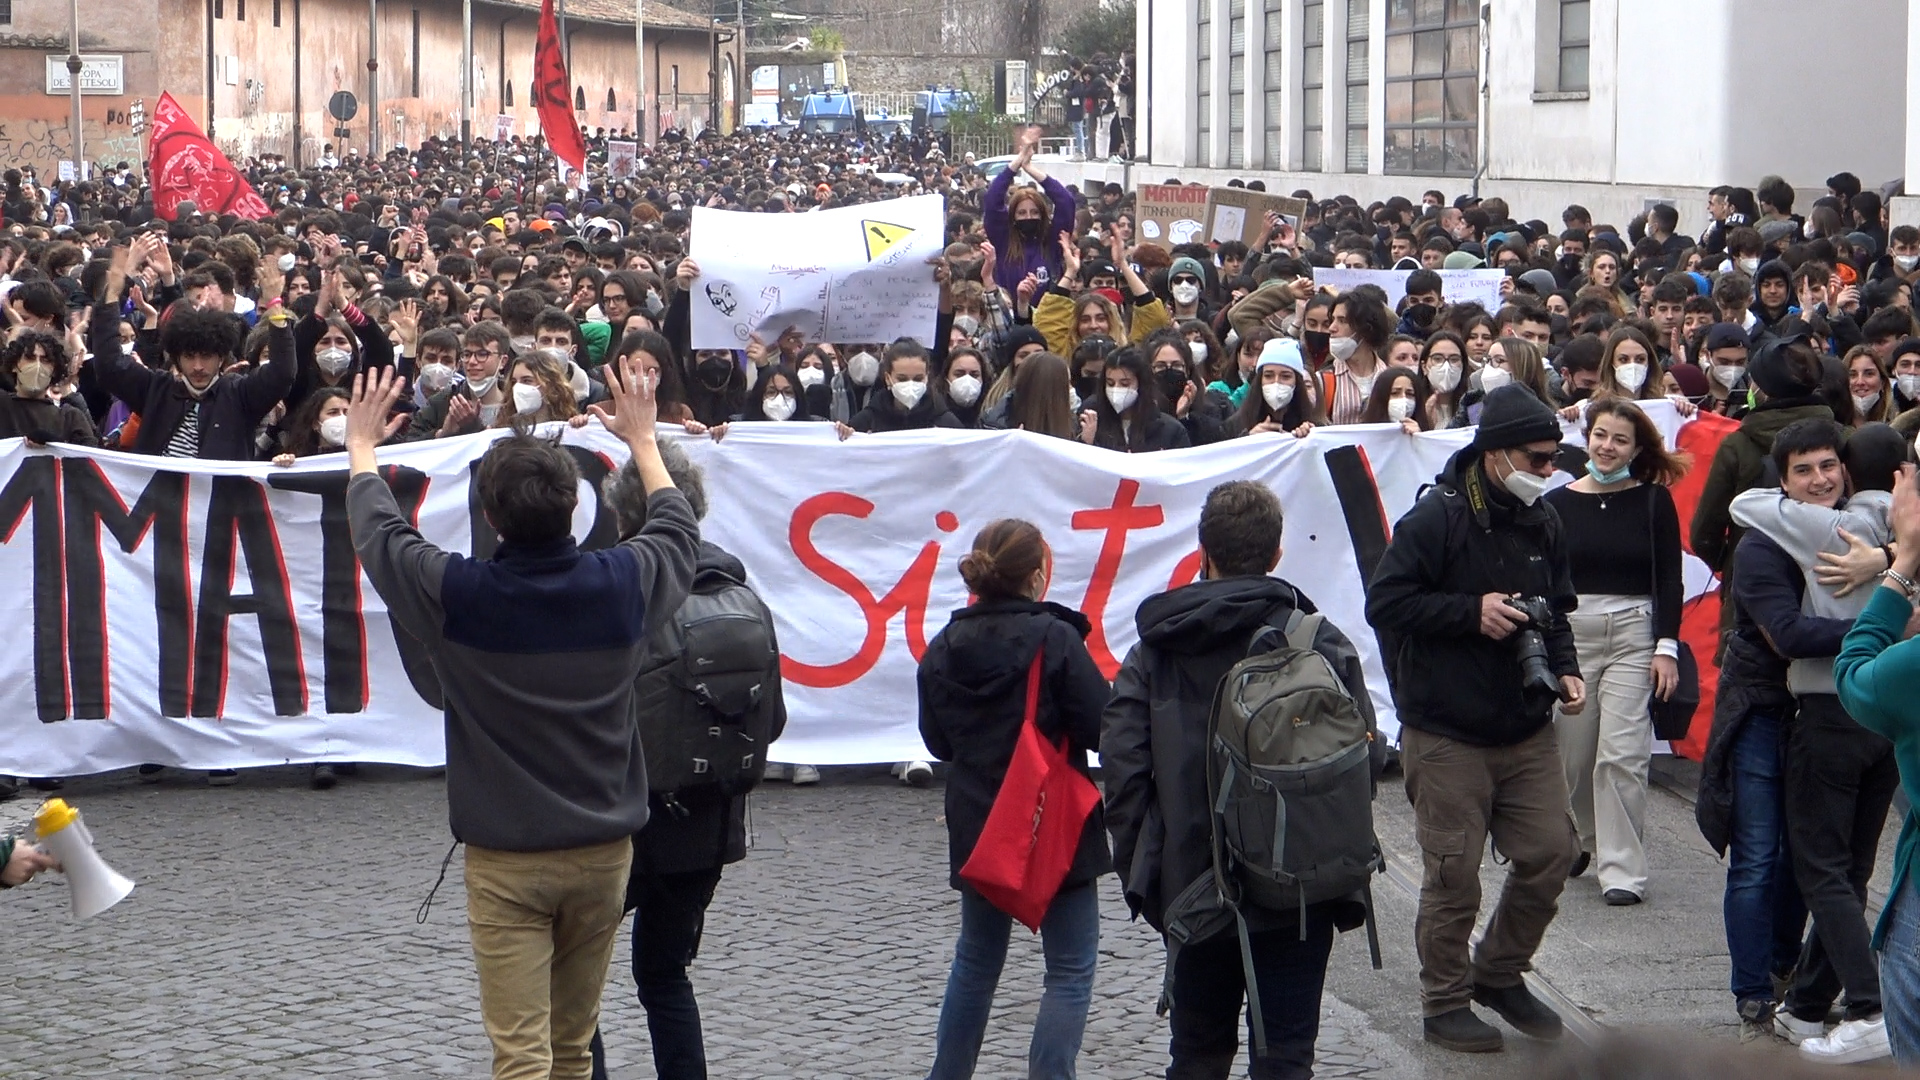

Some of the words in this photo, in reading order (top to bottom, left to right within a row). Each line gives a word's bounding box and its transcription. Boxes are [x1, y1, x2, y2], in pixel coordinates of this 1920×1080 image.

[53, 78, 65, 87] DE
[67, 78, 116, 87] STTESOLI
[1033, 70, 1069, 100] NUOVO
